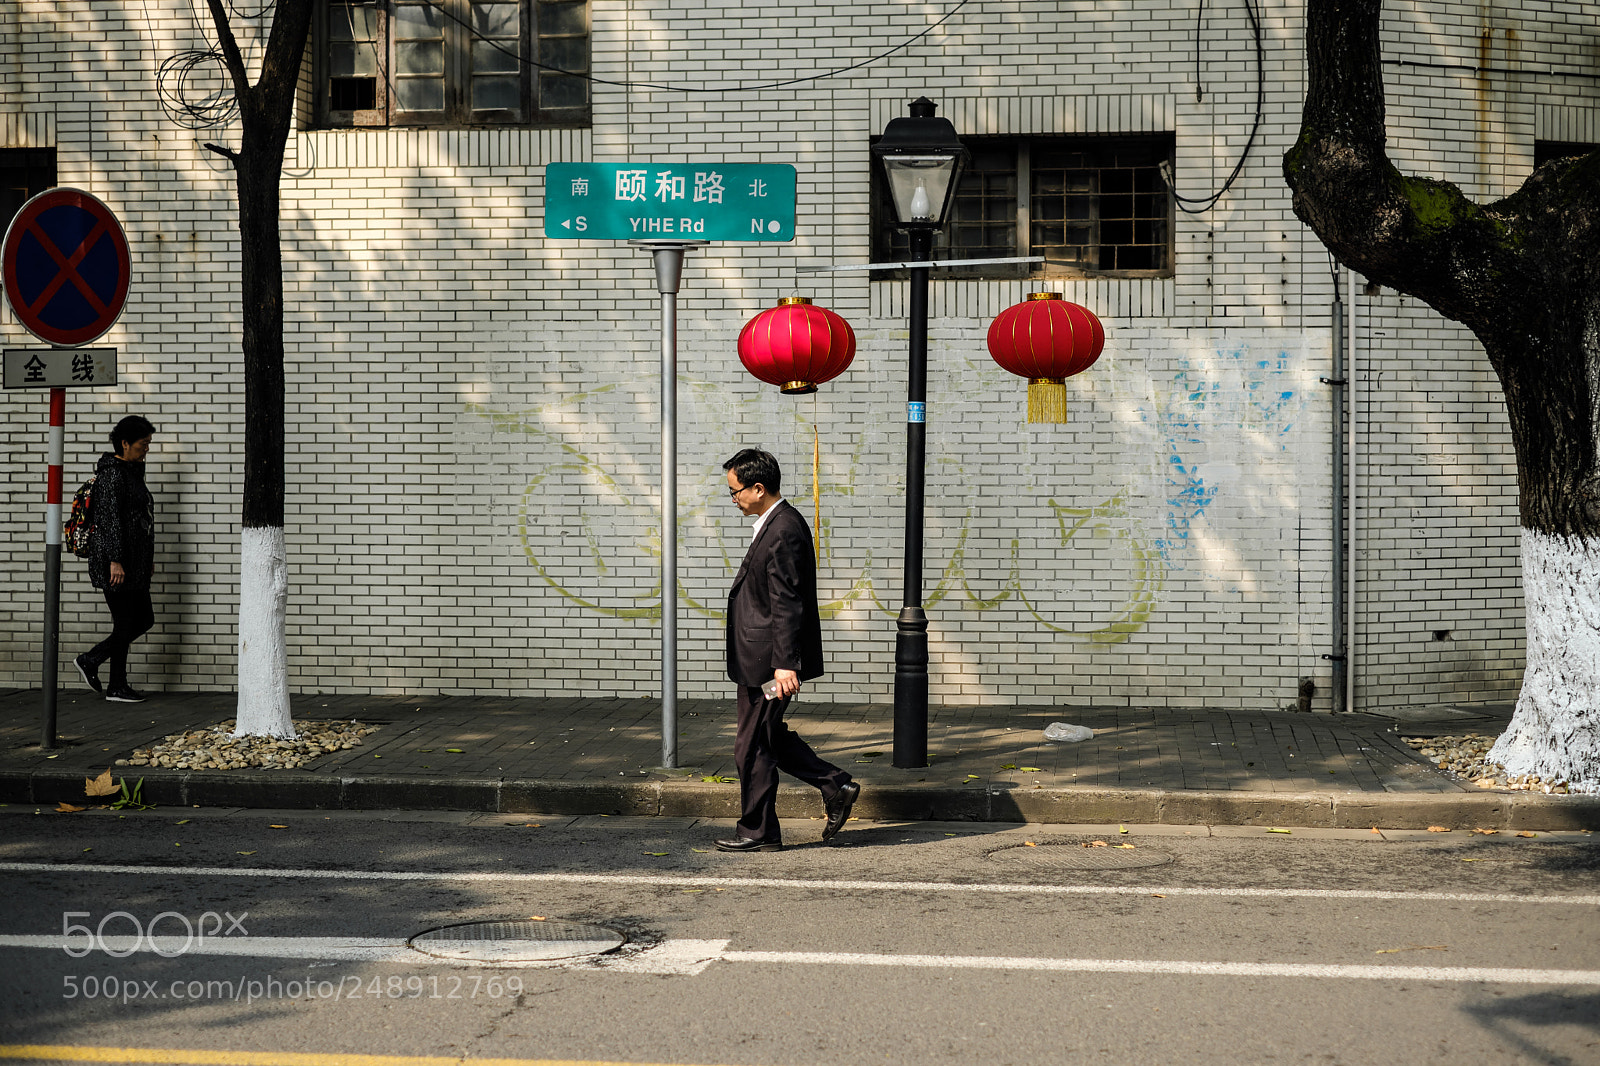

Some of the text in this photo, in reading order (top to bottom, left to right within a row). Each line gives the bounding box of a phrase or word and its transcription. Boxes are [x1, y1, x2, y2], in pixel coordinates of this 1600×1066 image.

[571, 178, 589, 196] 南
[615, 169, 725, 204] 颐和路
[749, 179, 767, 197] 北
[575, 216, 588, 231] S
[629, 218, 705, 233] YIHE Rd
[751, 219, 763, 233] N
[23, 354, 94, 382] 全线
